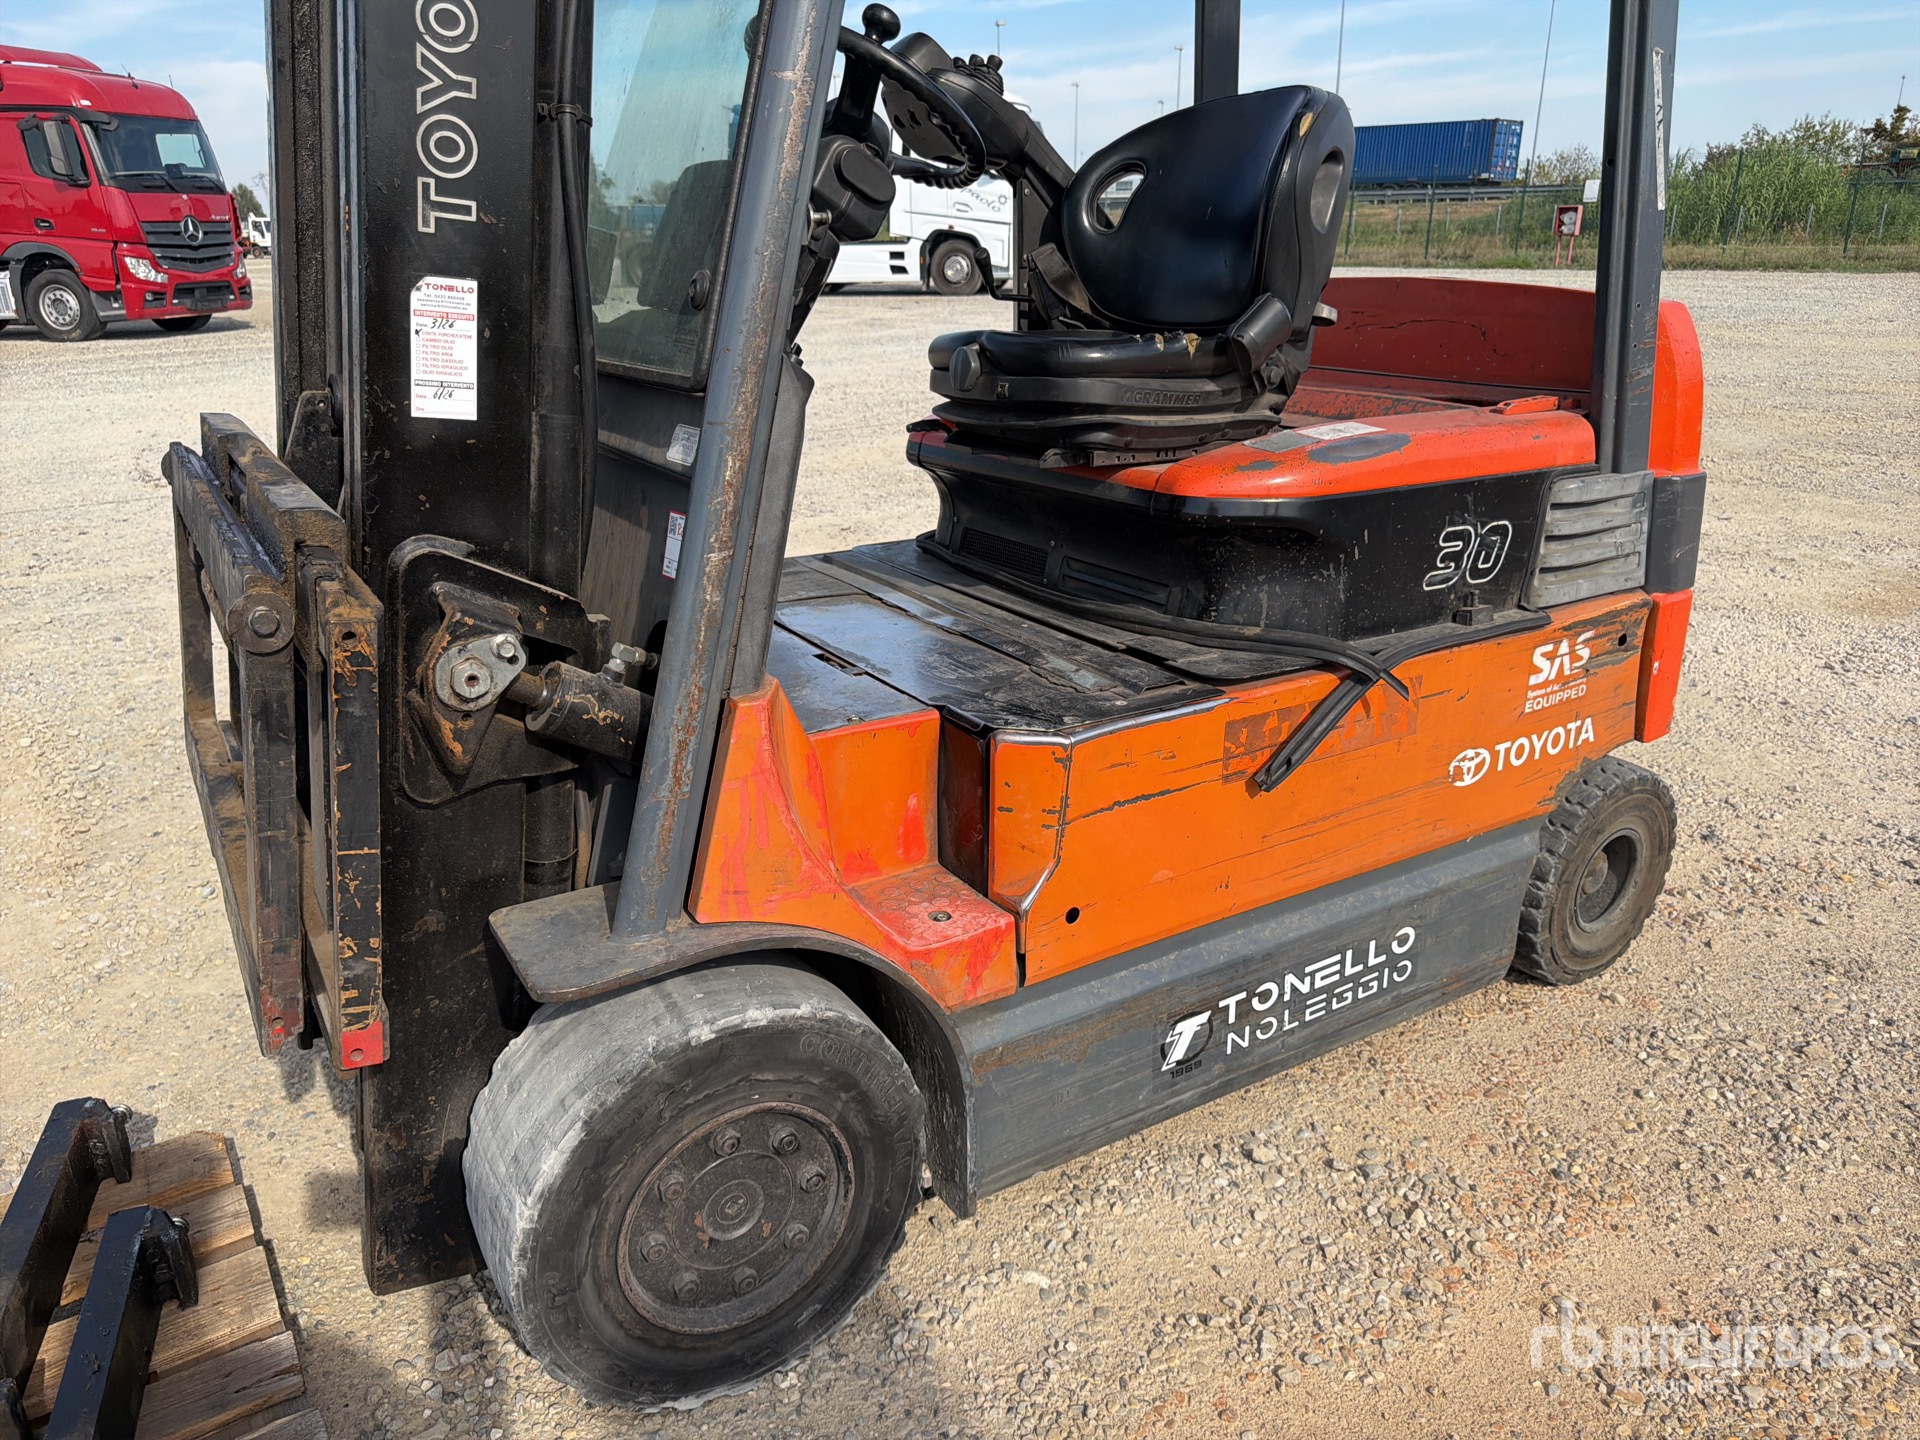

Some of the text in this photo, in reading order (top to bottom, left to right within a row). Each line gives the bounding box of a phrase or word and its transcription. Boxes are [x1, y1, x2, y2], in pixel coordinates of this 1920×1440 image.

[414, 309, 474, 321] INTERVENTO ESEGUITO
[424, 282, 475, 294] TONELLO
[1133, 389, 1202, 406] GRAMMER
[1423, 520, 1512, 591] 30
[1528, 630, 1595, 686] SAS
[1524, 684, 1587, 713] EQUIPPED
[1494, 717, 1595, 771] TOYOTA
[1218, 926, 1416, 1025] TONELLO
[1226, 959, 1413, 1055] NOLEGGIO
